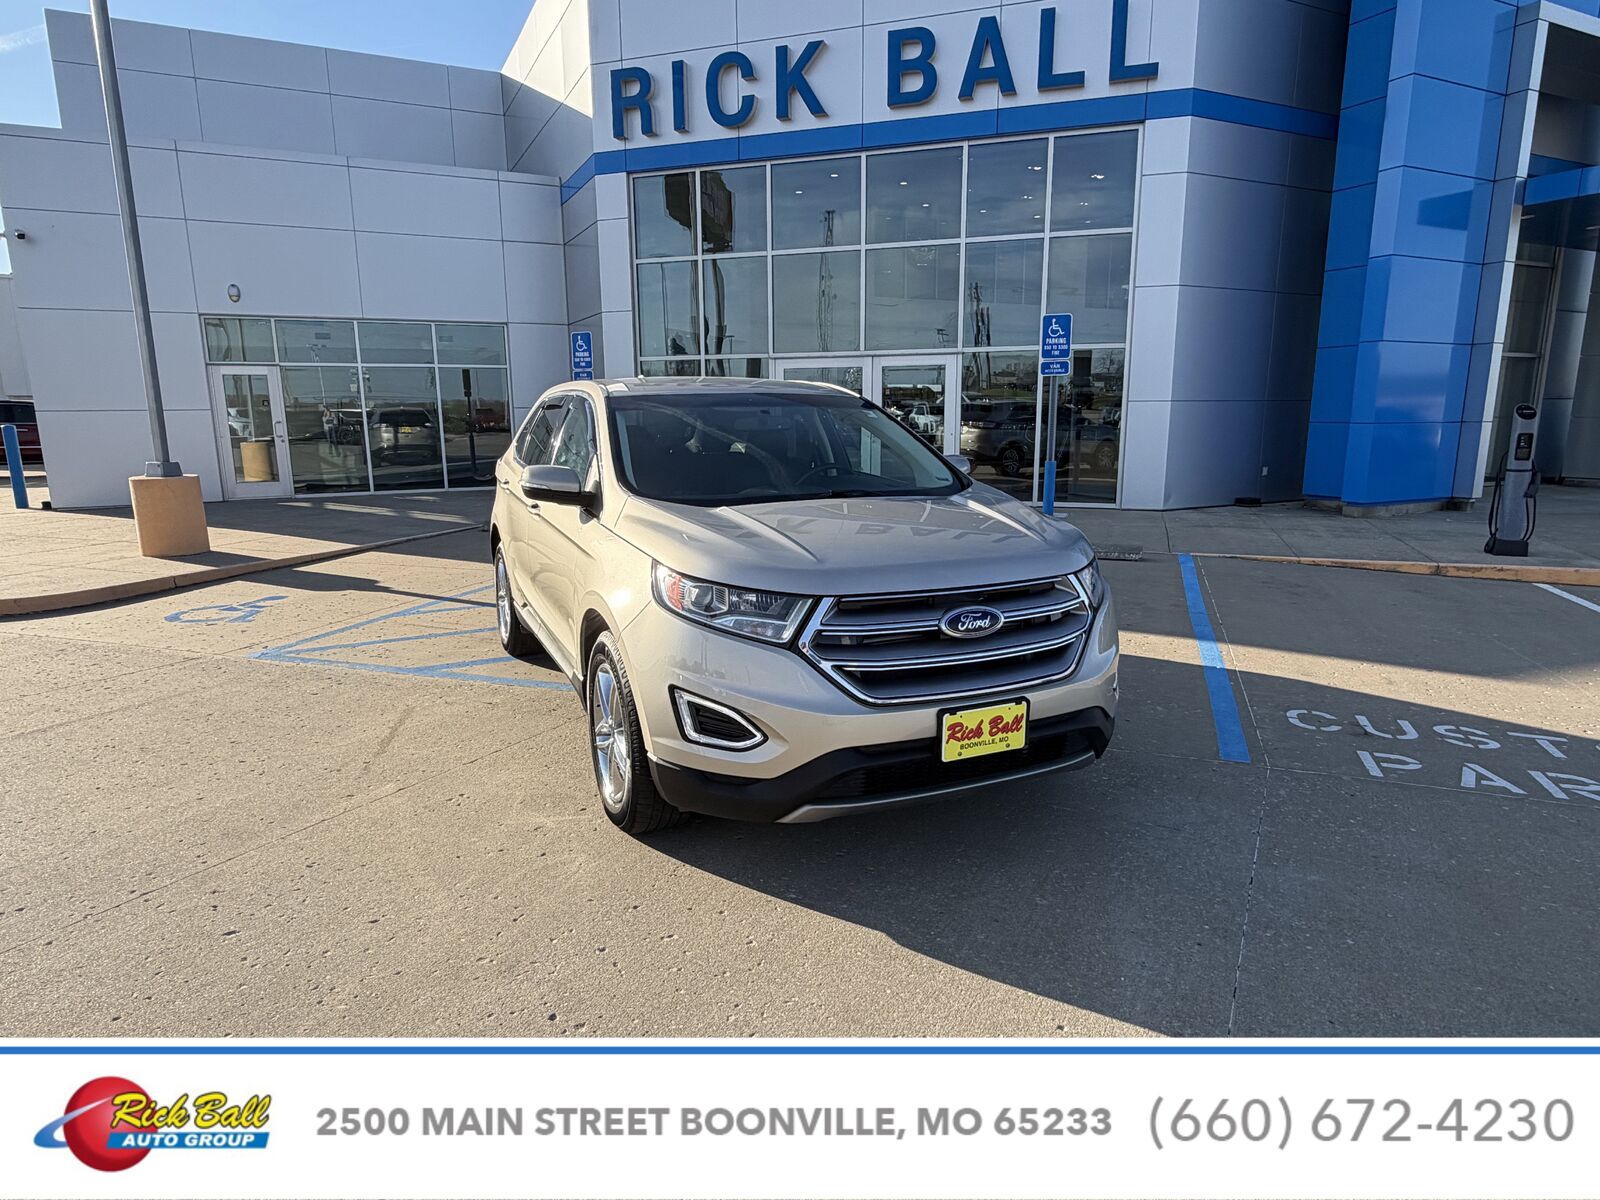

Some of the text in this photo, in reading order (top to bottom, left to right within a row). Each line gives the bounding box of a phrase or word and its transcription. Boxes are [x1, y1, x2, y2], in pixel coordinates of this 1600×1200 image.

[610, 0, 1160, 141] RICK BALL
[958, 612, 992, 631] Ford
[946, 713, 1025, 744] Rick Ball
[960, 738, 998, 750] BOONVILLE,
[1285, 709, 1600, 760] CUST
